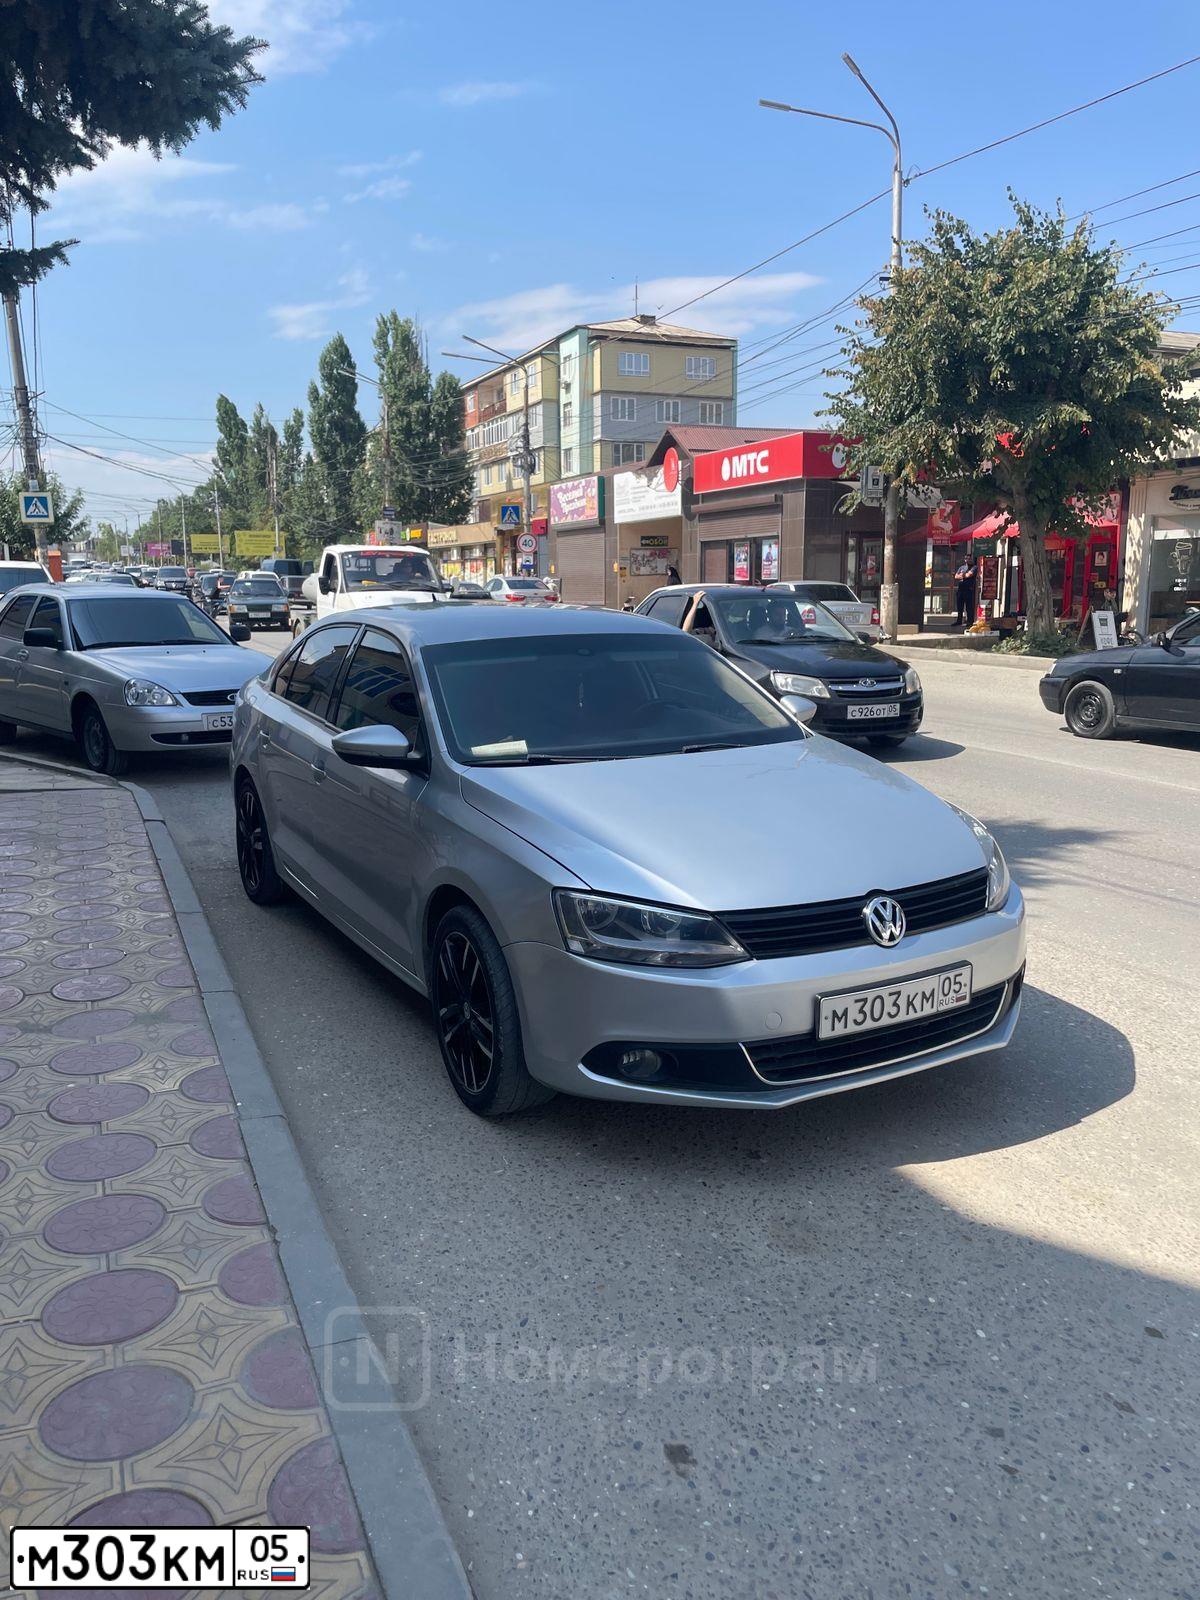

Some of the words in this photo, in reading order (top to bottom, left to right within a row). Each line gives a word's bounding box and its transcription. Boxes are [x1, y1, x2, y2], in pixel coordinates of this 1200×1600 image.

[731, 449, 769, 479] МТС
[521, 539, 534, 548] 40
[850, 706, 887, 718] С926ОТ
[888, 704, 897, 713] 05
[830, 987, 936, 1033] М303КМ
[941, 972, 963, 998] 05
[938, 997, 956, 1008] RUS
